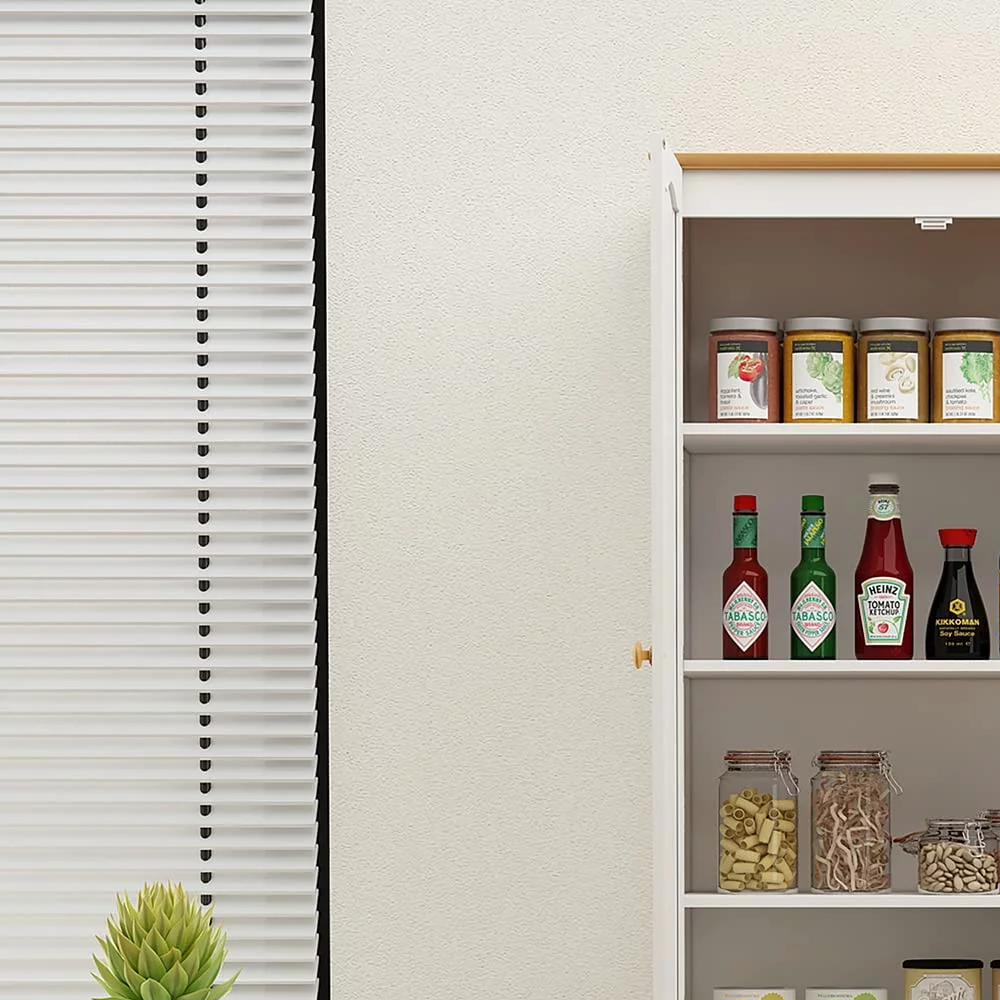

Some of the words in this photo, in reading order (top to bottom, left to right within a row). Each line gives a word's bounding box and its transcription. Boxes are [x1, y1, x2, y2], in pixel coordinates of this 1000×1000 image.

[869, 585, 899, 596] HEINZ
[868, 601, 900, 609] TOMATO
[724, 612, 766, 621] TABASCO
[792, 612, 834, 621] TABASCO
